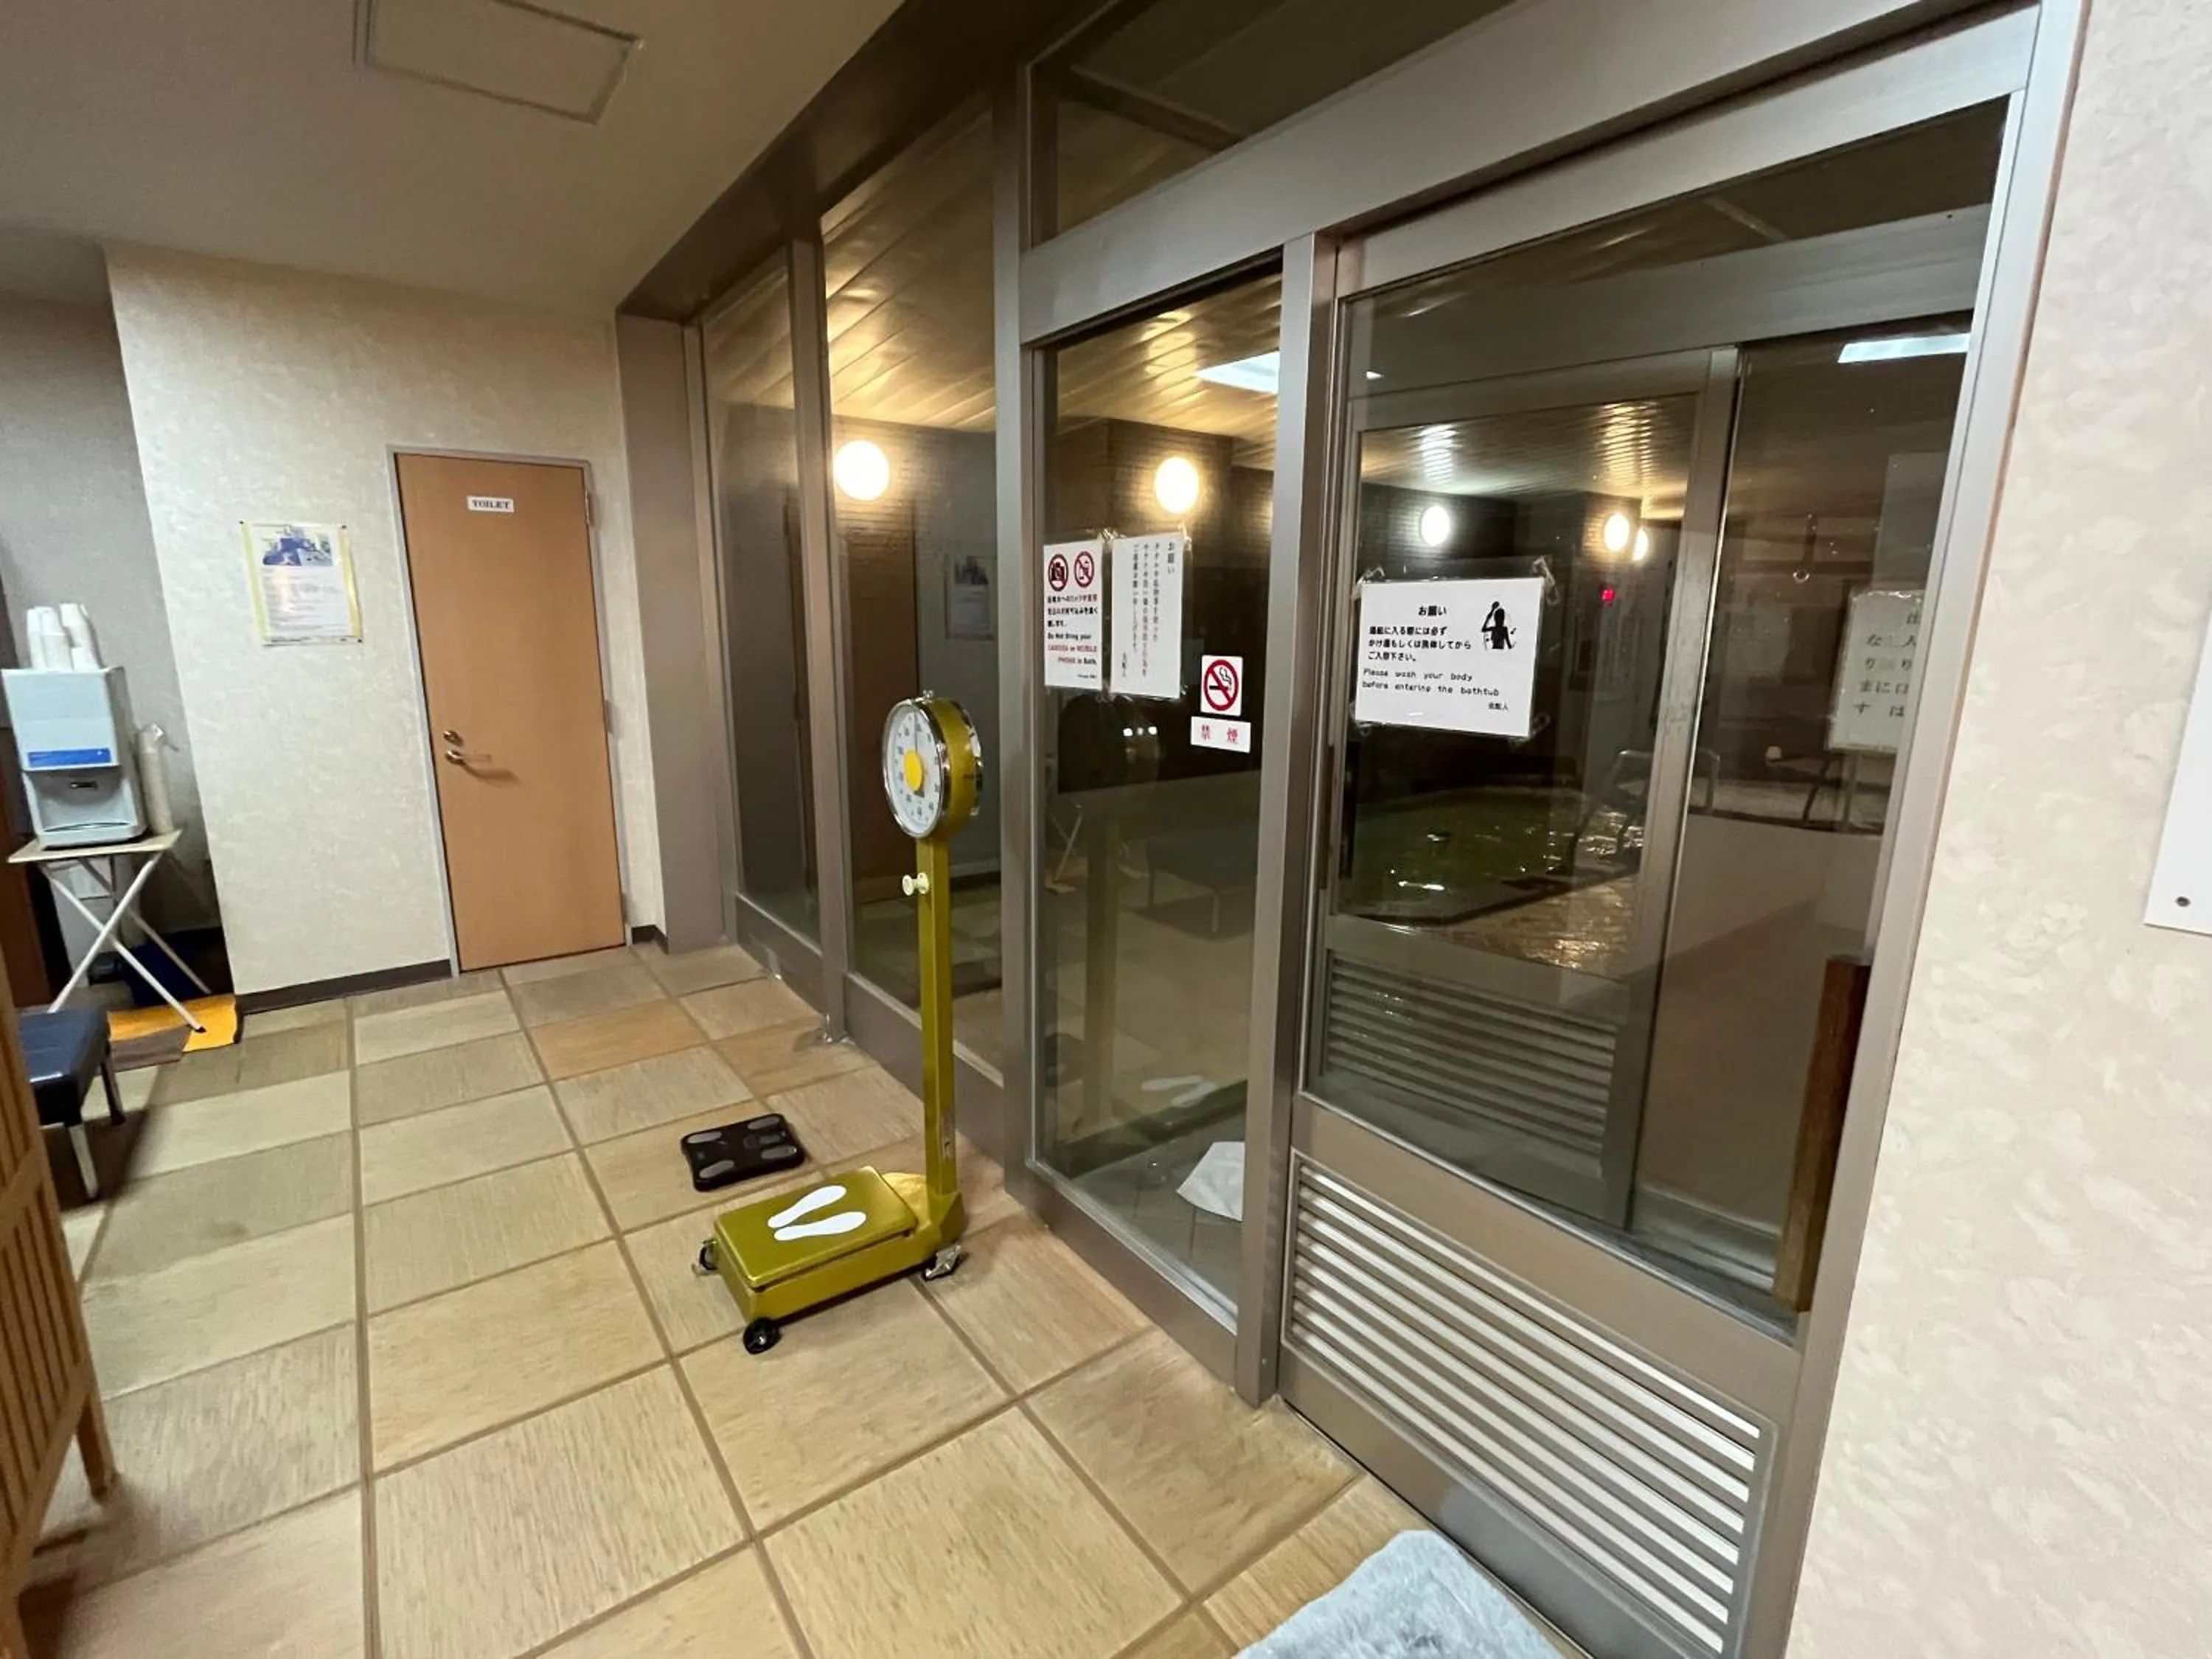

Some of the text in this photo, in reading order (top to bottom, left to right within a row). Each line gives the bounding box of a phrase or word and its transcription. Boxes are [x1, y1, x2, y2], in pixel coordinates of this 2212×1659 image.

[1418, 605, 1447, 616] お願い
[1363, 669, 1472, 681] Please wash your body
[1362, 681, 1388, 689] before
[1394, 683, 1430, 692] entering
[1438, 686, 1453, 694] the
